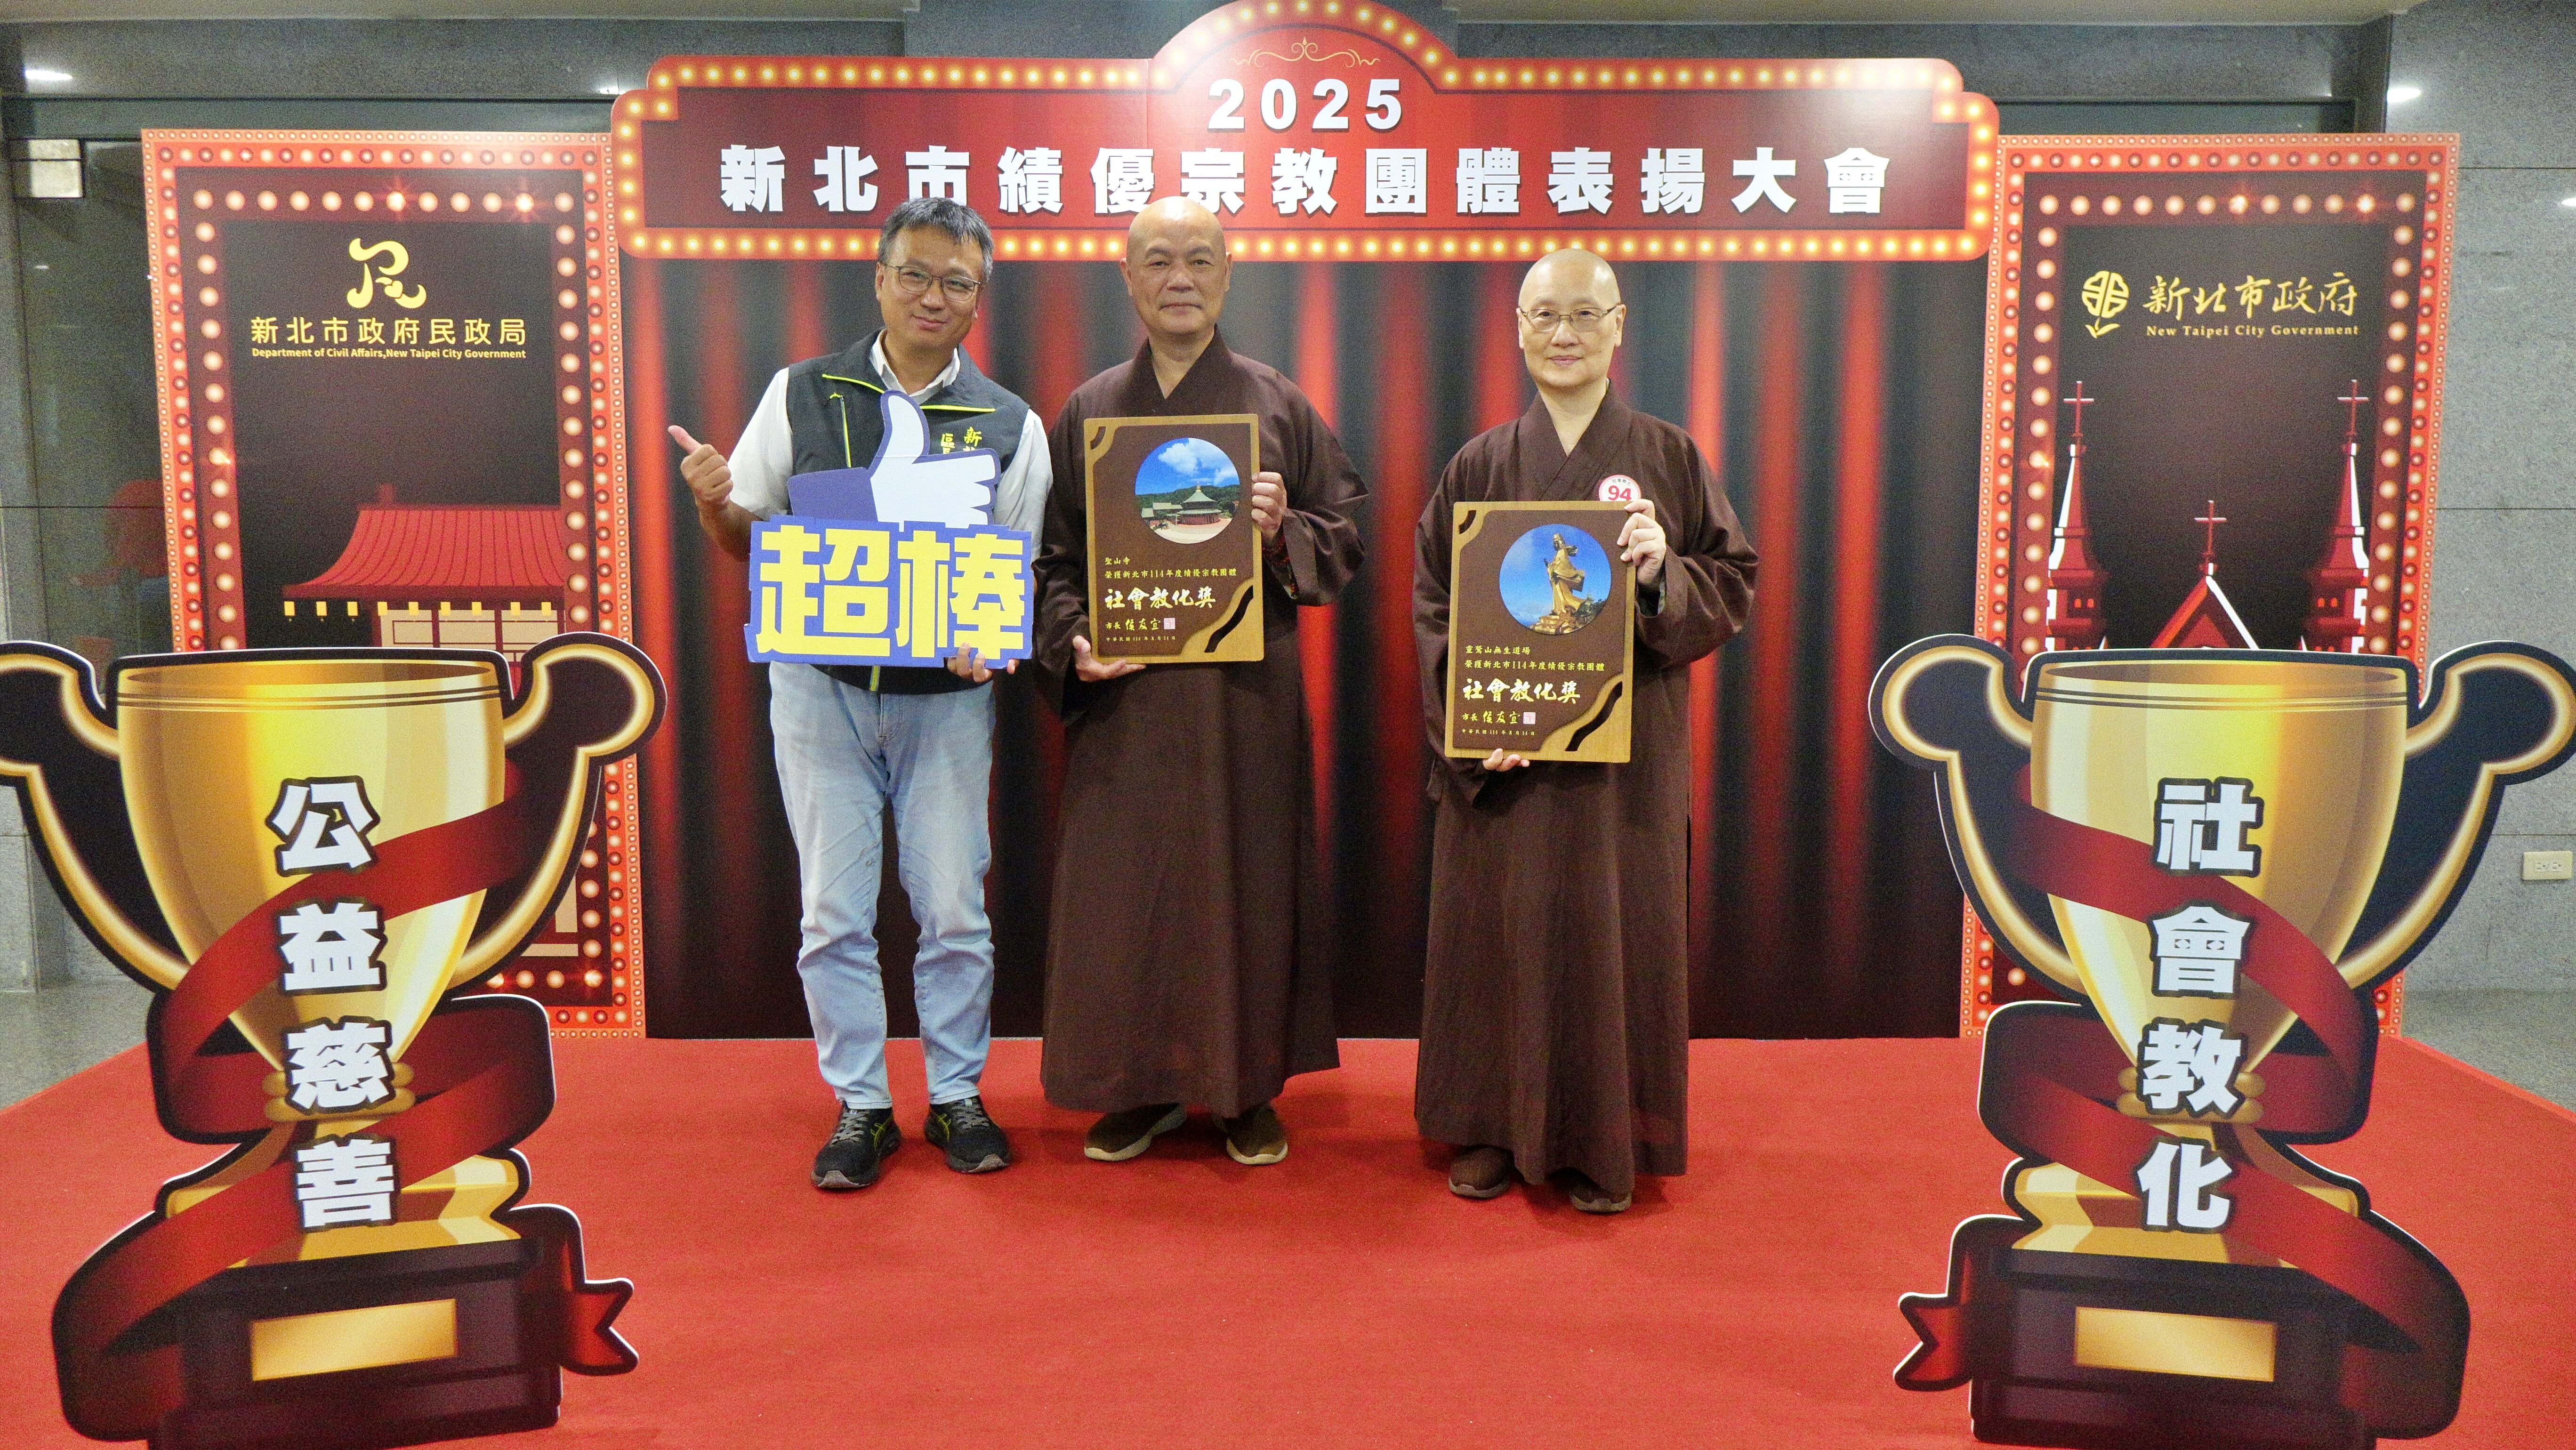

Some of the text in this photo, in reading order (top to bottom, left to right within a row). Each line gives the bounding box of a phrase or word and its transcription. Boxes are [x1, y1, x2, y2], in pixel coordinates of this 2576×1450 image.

[1207, 78, 1402, 131] 2025
[720, 145, 1891, 215] 新北市績優宗教團體表揚大會
[2142, 271, 2358, 321] 新北市政府
[250, 316, 526, 345] 新北市政府民政局
[2146, 324, 2359, 338] New Taipei City Government
[251, 347, 313, 359] Department
[314, 347, 325, 357] of
[326, 347, 349, 357] Civil
[410, 348, 440, 360] Taipei
[442, 348, 463, 360] City
[464, 348, 526, 359] Government
[963, 426, 982, 451] 新
[1608, 485, 1632, 501] 94
[1104, 556, 1131, 565] 聖山寺
[756, 524, 1025, 660] 超棒
[1465, 644, 1531, 655] 靈鷲山無生道場
[273, 782, 394, 1228] 公益慈善
[2137, 783, 2258, 1228] 社會教化
